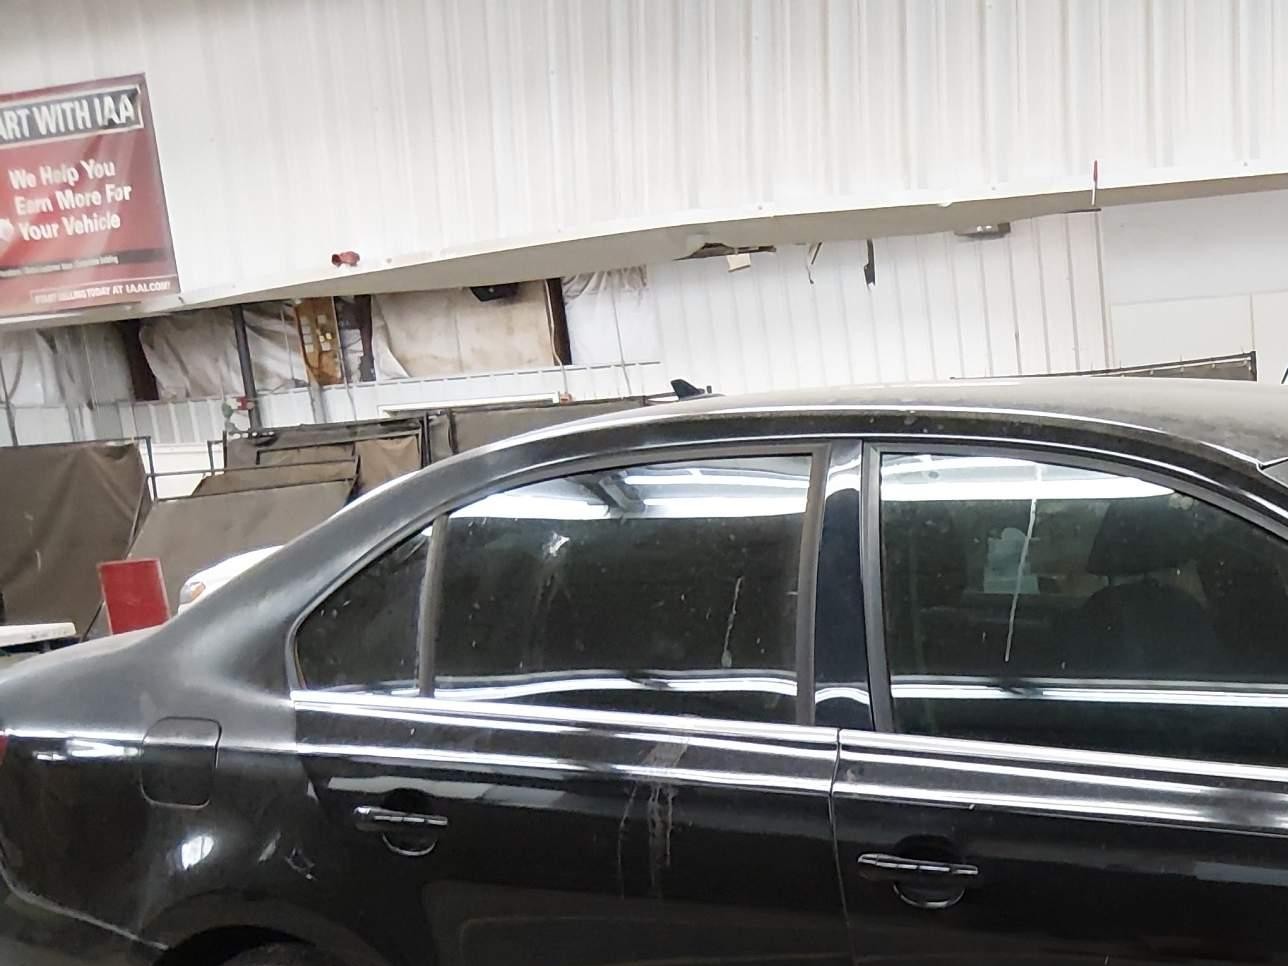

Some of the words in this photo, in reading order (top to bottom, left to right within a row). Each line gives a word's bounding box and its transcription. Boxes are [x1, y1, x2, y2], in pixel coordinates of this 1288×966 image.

[33, 99, 92, 135] WITH
[94, 94, 135, 126] IAA
[8, 168, 36, 189] We
[40, 163, 79, 187] Help
[80, 159, 116, 180] You
[15, 194, 53, 216] Earn
[55, 190, 102, 212] More
[105, 184, 132, 203] For
[17, 220, 60, 242] Your
[61, 212, 122, 236] Vehicle
[112, 285, 124, 295] AT
